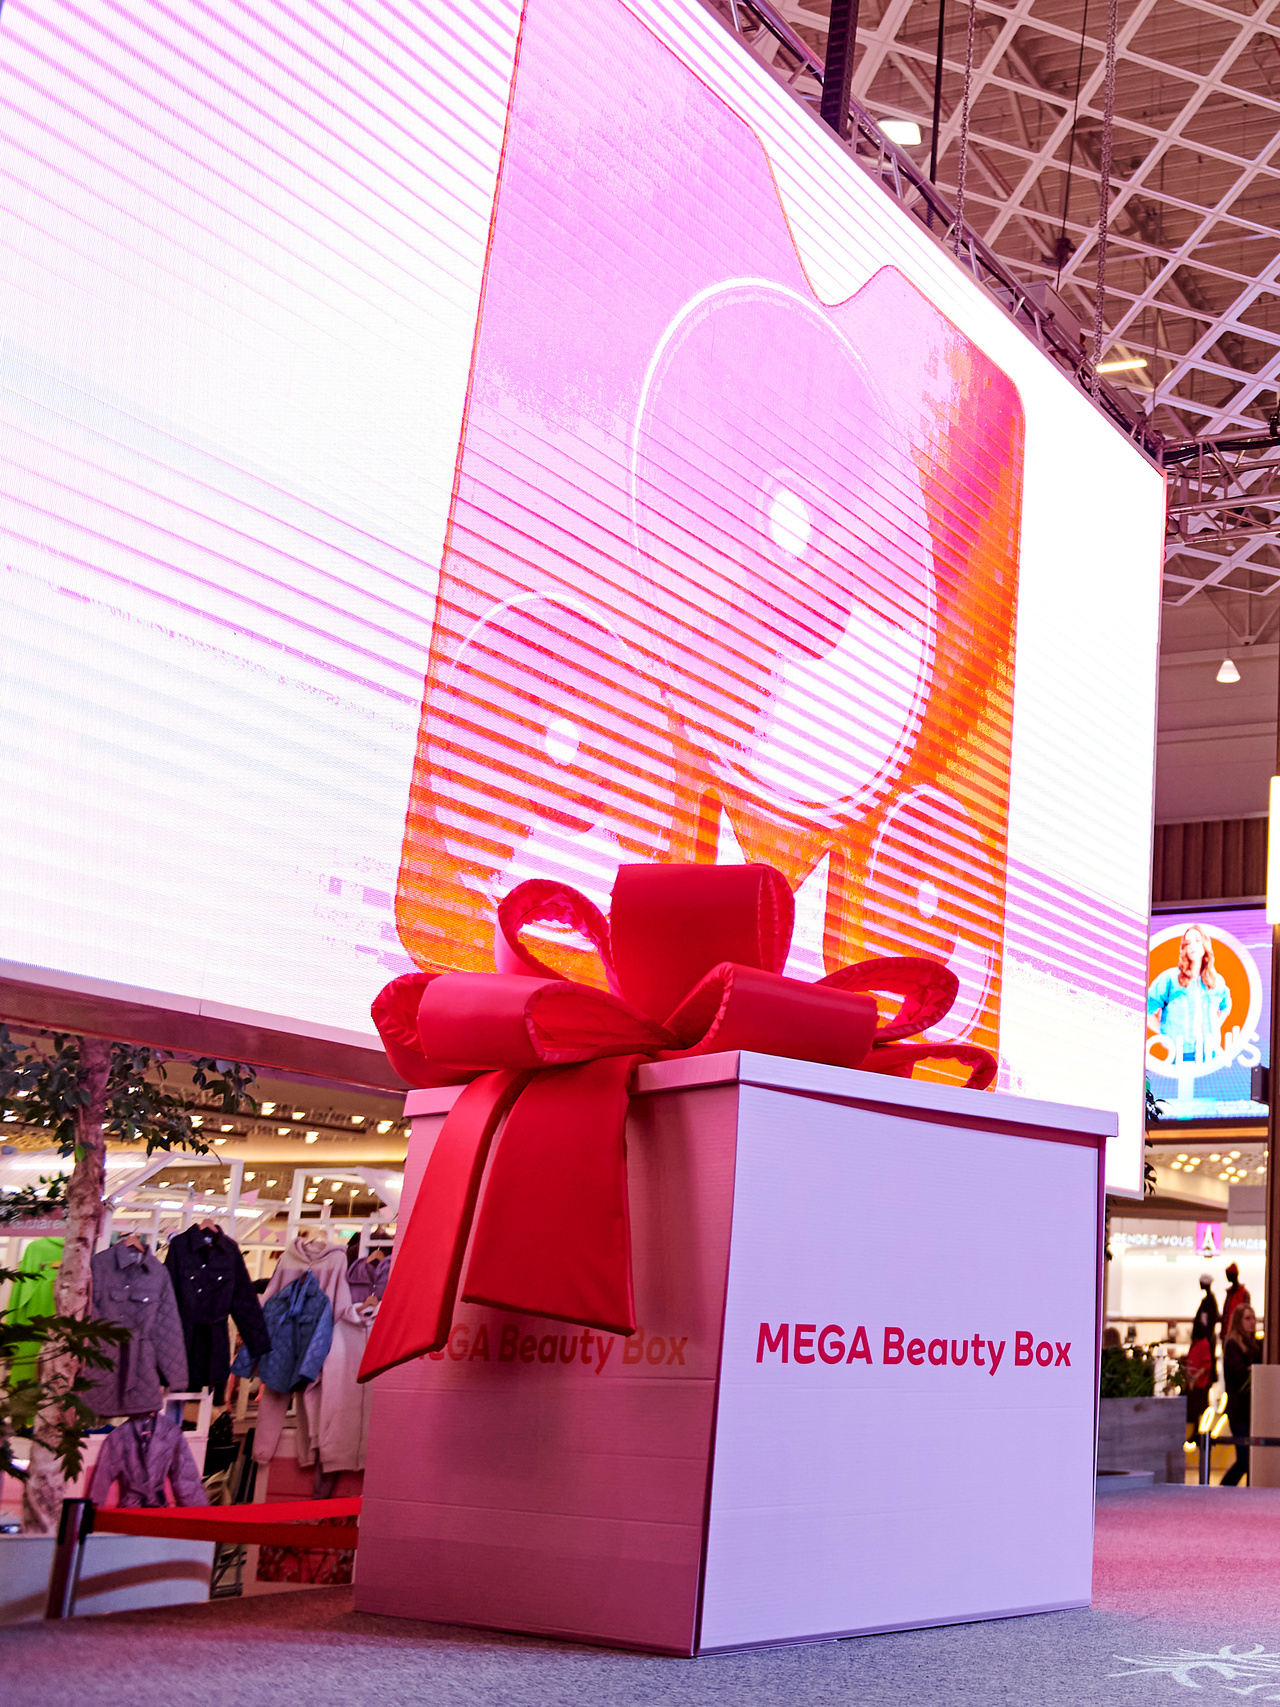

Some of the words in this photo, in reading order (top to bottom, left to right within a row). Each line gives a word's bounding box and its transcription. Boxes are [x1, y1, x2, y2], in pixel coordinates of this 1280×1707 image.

[1145, 1025, 1262, 1068] OLIN'S
[420, 1324, 490, 1362] GA
[500, 1324, 614, 1375] Beauty
[622, 1325, 688, 1366] Box
[756, 1322, 873, 1365] MEGA
[883, 1326, 1006, 1377] Beauty
[1014, 1330, 1072, 1367] Box
